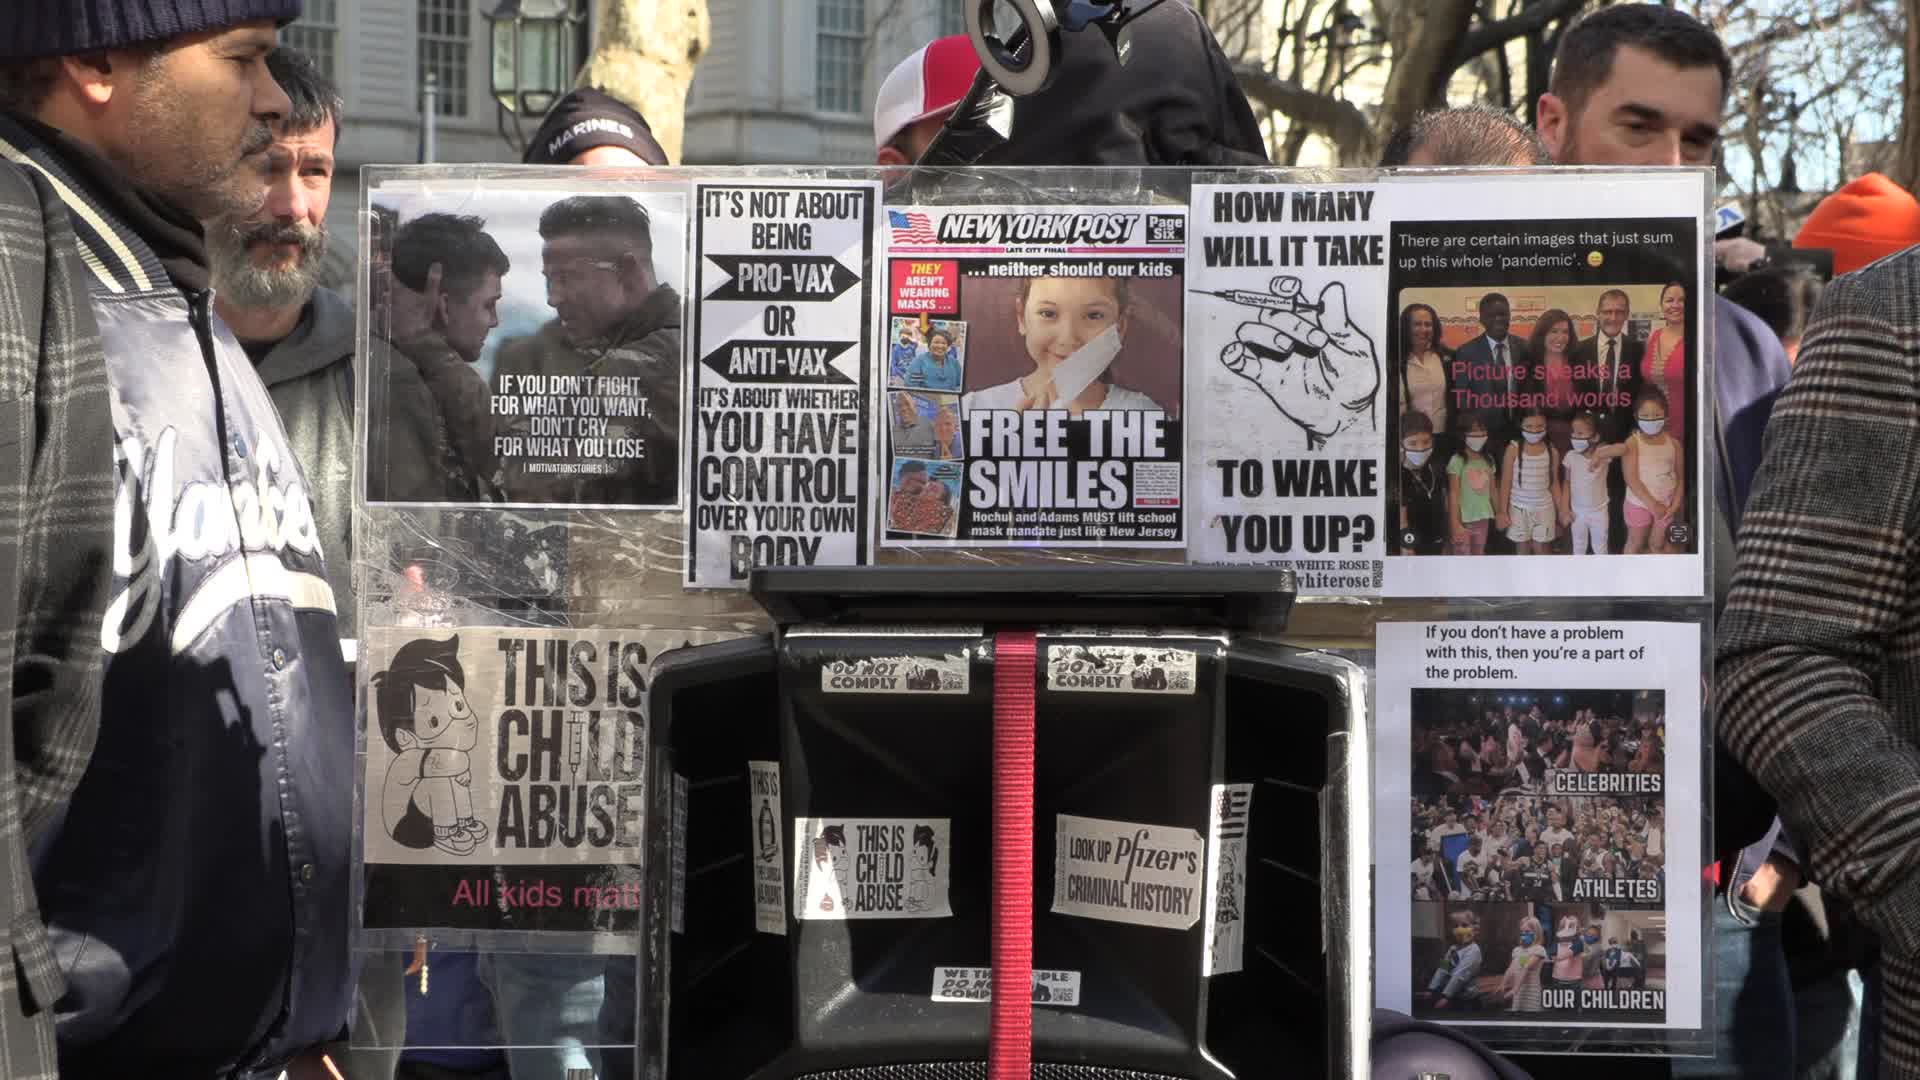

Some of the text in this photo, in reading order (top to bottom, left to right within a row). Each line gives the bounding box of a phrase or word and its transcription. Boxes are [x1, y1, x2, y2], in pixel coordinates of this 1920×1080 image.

[548, 118, 634, 156] MARINES
[705, 191, 863, 220] IT'S NOT ABOUT
[1214, 191, 1374, 223] HOW MANY
[938, 214, 1140, 244] NEW YORK POST
[1149, 215, 1183, 230] Page
[751, 223, 812, 250] BEING
[1400, 231, 1673, 249] There are certain images that just sum
[1203, 235, 1384, 267] WILL IT TAKE
[1399, 258, 1417, 270] up
[1421, 254, 1448, 267] this
[1451, 253, 1494, 267] whole
[737, 262, 836, 293] PRO-VAX
[910, 263, 942, 275] THEY
[1049, 261, 1103, 276] should
[1107, 265, 1135, 276] our
[1138, 261, 1173, 276] kids
[900, 287, 950, 298] WEARING
[905, 276, 945, 287] AREN'T
[763, 305, 796, 336] OR
[727, 347, 828, 376] ANTI-VAX
[1452, 359, 1632, 384] Picture speaks a
[499, 374, 641, 396] IF YOU DON'T FIGHT
[490, 395, 652, 420] FOR WHAT YOU WANT,
[700, 387, 859, 410] IT'S ABOUT WHETHER
[1452, 388, 1632, 409] Thousand words
[530, 416, 609, 437] DON'T CRY
[700, 411, 857, 454] YOU HAVE
[968, 409, 1166, 457] FREE THE
[494, 436, 645, 458] FOR WHAT YOU LOSE
[700, 455, 857, 504] CONTROL
[968, 459, 1128, 509] SMILES
[1216, 458, 1264, 498] TO
[1272, 458, 1378, 497] WAKE
[698, 504, 855, 533] OVER YOUR OWN
[972, 510, 1177, 524] Hochul and Adams MUST lift school
[971, 524, 1178, 540] mask mandate just like New Jersey
[1219, 513, 1376, 554] YOU UP?
[1295, 560, 1336, 570] WHITE
[1338, 560, 1370, 570] ROSE
[1426, 625, 1624, 642] If you don't have a problem
[1426, 645, 1645, 662] with this, then you're a part of
[498, 638, 648, 708] THIS IS
[862, 662, 899, 676] NOT
[1056, 660, 1084, 674] DO
[1426, 665, 1518, 682] the problem.
[830, 676, 898, 690] COMPLY
[1056, 675, 1123, 689] COMPLY
[752, 769, 770, 796] THIS
[1556, 773, 1661, 793] CELEBRITIES
[495, 785, 641, 848] ABUSE
[856, 825, 905, 852] THIS IS
[1070, 837, 1097, 861] LOOK
[1097, 840, 1112, 863] UP
[453, 879, 490, 905] All
[502, 879, 562, 906] kids
[855, 884, 904, 912] ABUSE
[1068, 873, 1194, 916] CRIMINAL HISTORY
[1572, 879, 1658, 898] ATHLETES
[942, 979, 968, 988] DO
[944, 969, 968, 978] WE
[974, 970, 992, 979] TH
[1542, 990, 1664, 1009] OUR CHILDREN
